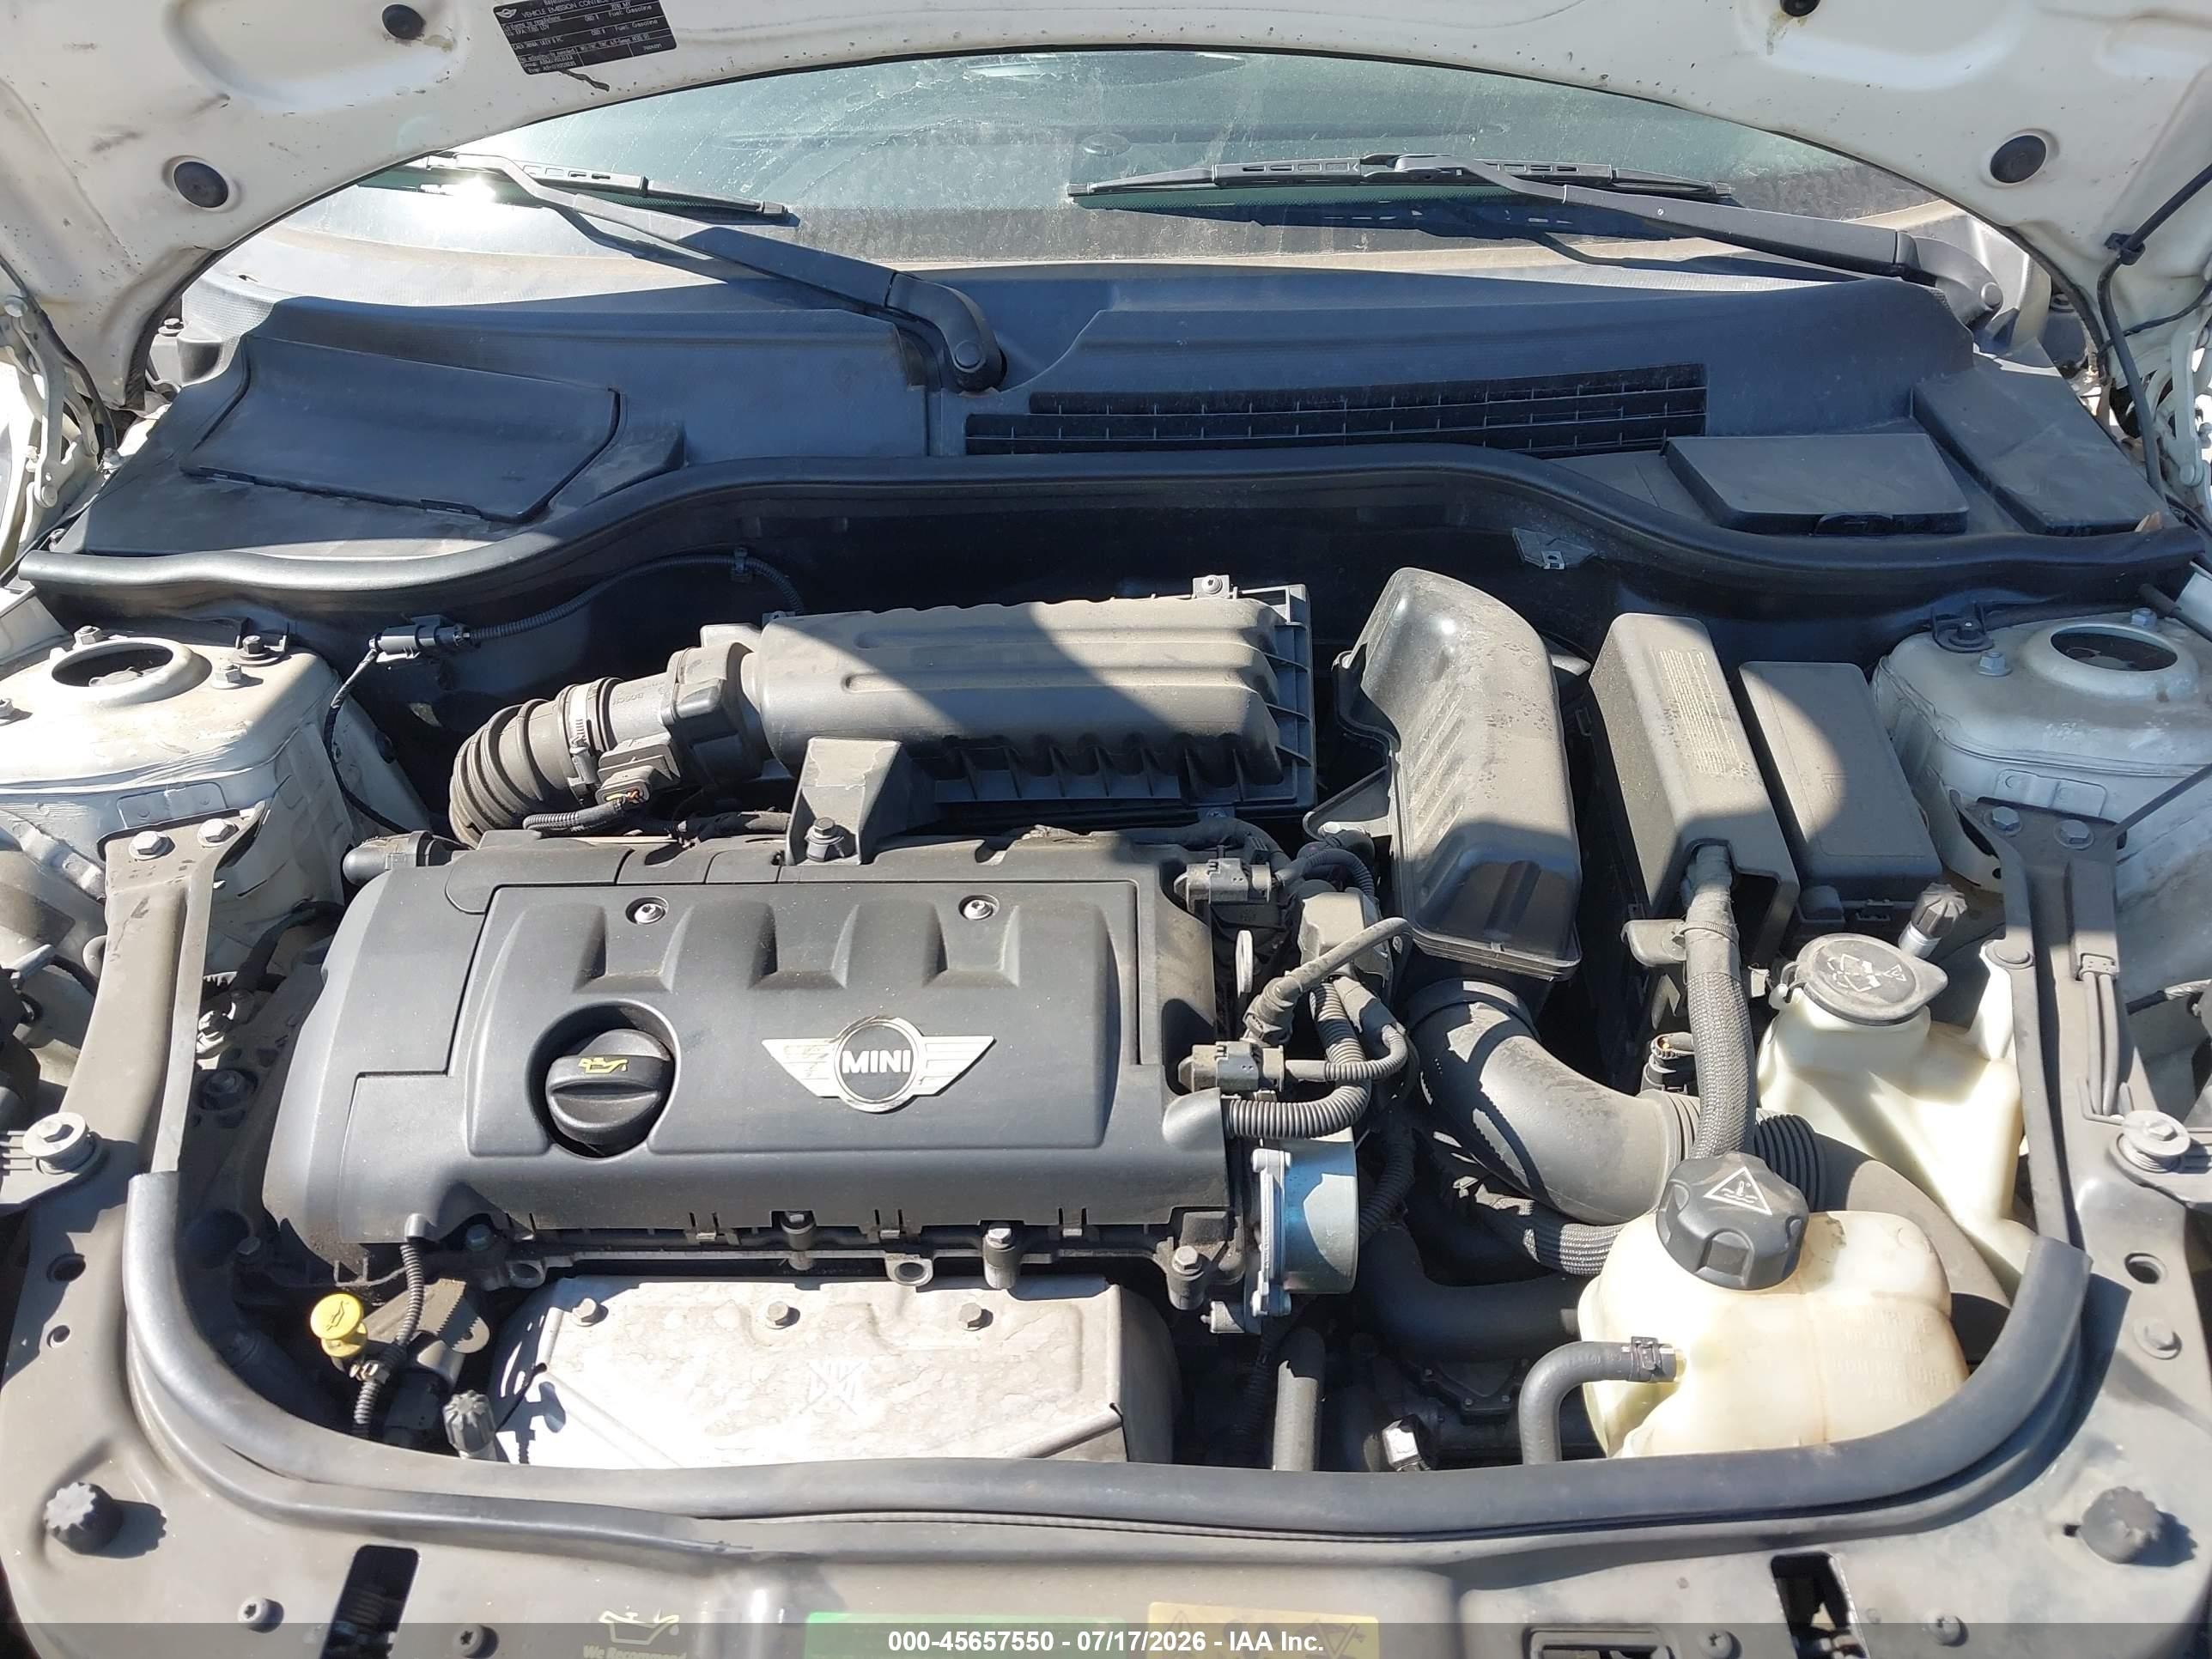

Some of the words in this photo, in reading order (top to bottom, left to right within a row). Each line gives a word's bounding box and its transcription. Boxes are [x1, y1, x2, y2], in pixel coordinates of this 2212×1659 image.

[521, 9, 546, 18] VEHICLE
[548, 3, 578, 13] EMISSION
[625, 5, 652, 15] Gasoline
[631, 19, 659, 27] Gasoline
[842, 1049, 912, 1074] MINI
[583, 1645, 605, 1659] We
